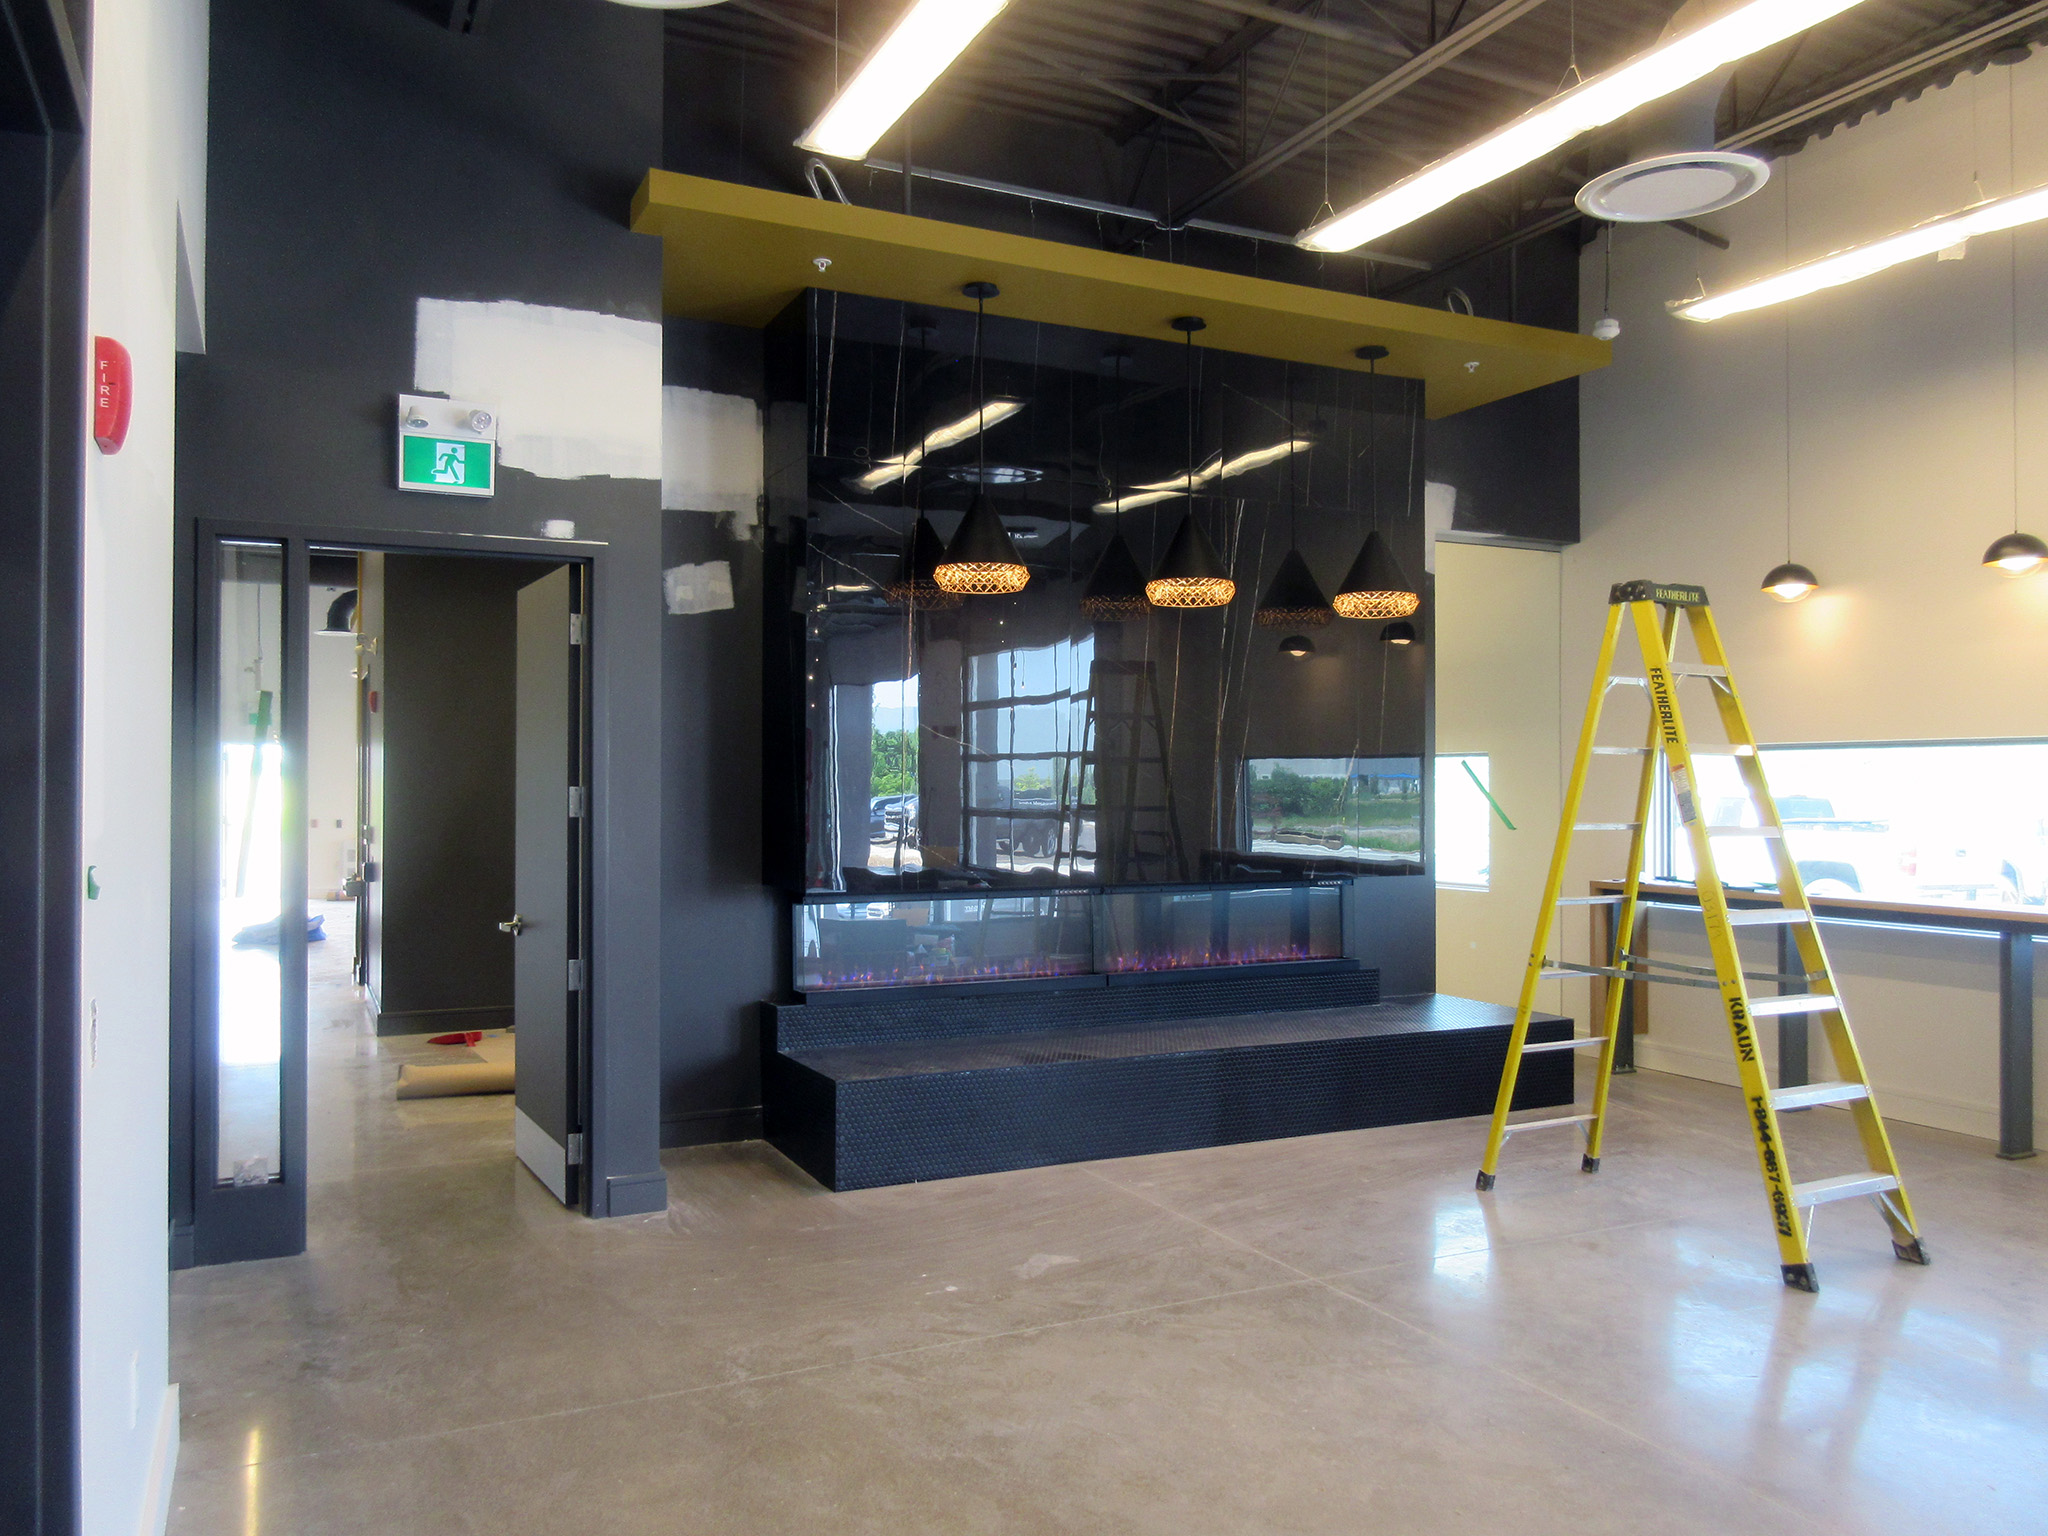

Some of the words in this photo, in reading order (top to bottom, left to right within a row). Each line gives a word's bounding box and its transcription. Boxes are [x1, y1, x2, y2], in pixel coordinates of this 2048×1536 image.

[100, 360, 111, 408] FIRE
[1655, 588, 1700, 602] FEATHERLITE
[1649, 667, 1679, 744] FEATHERLITE
[1728, 996, 1755, 1062] KRAUN
